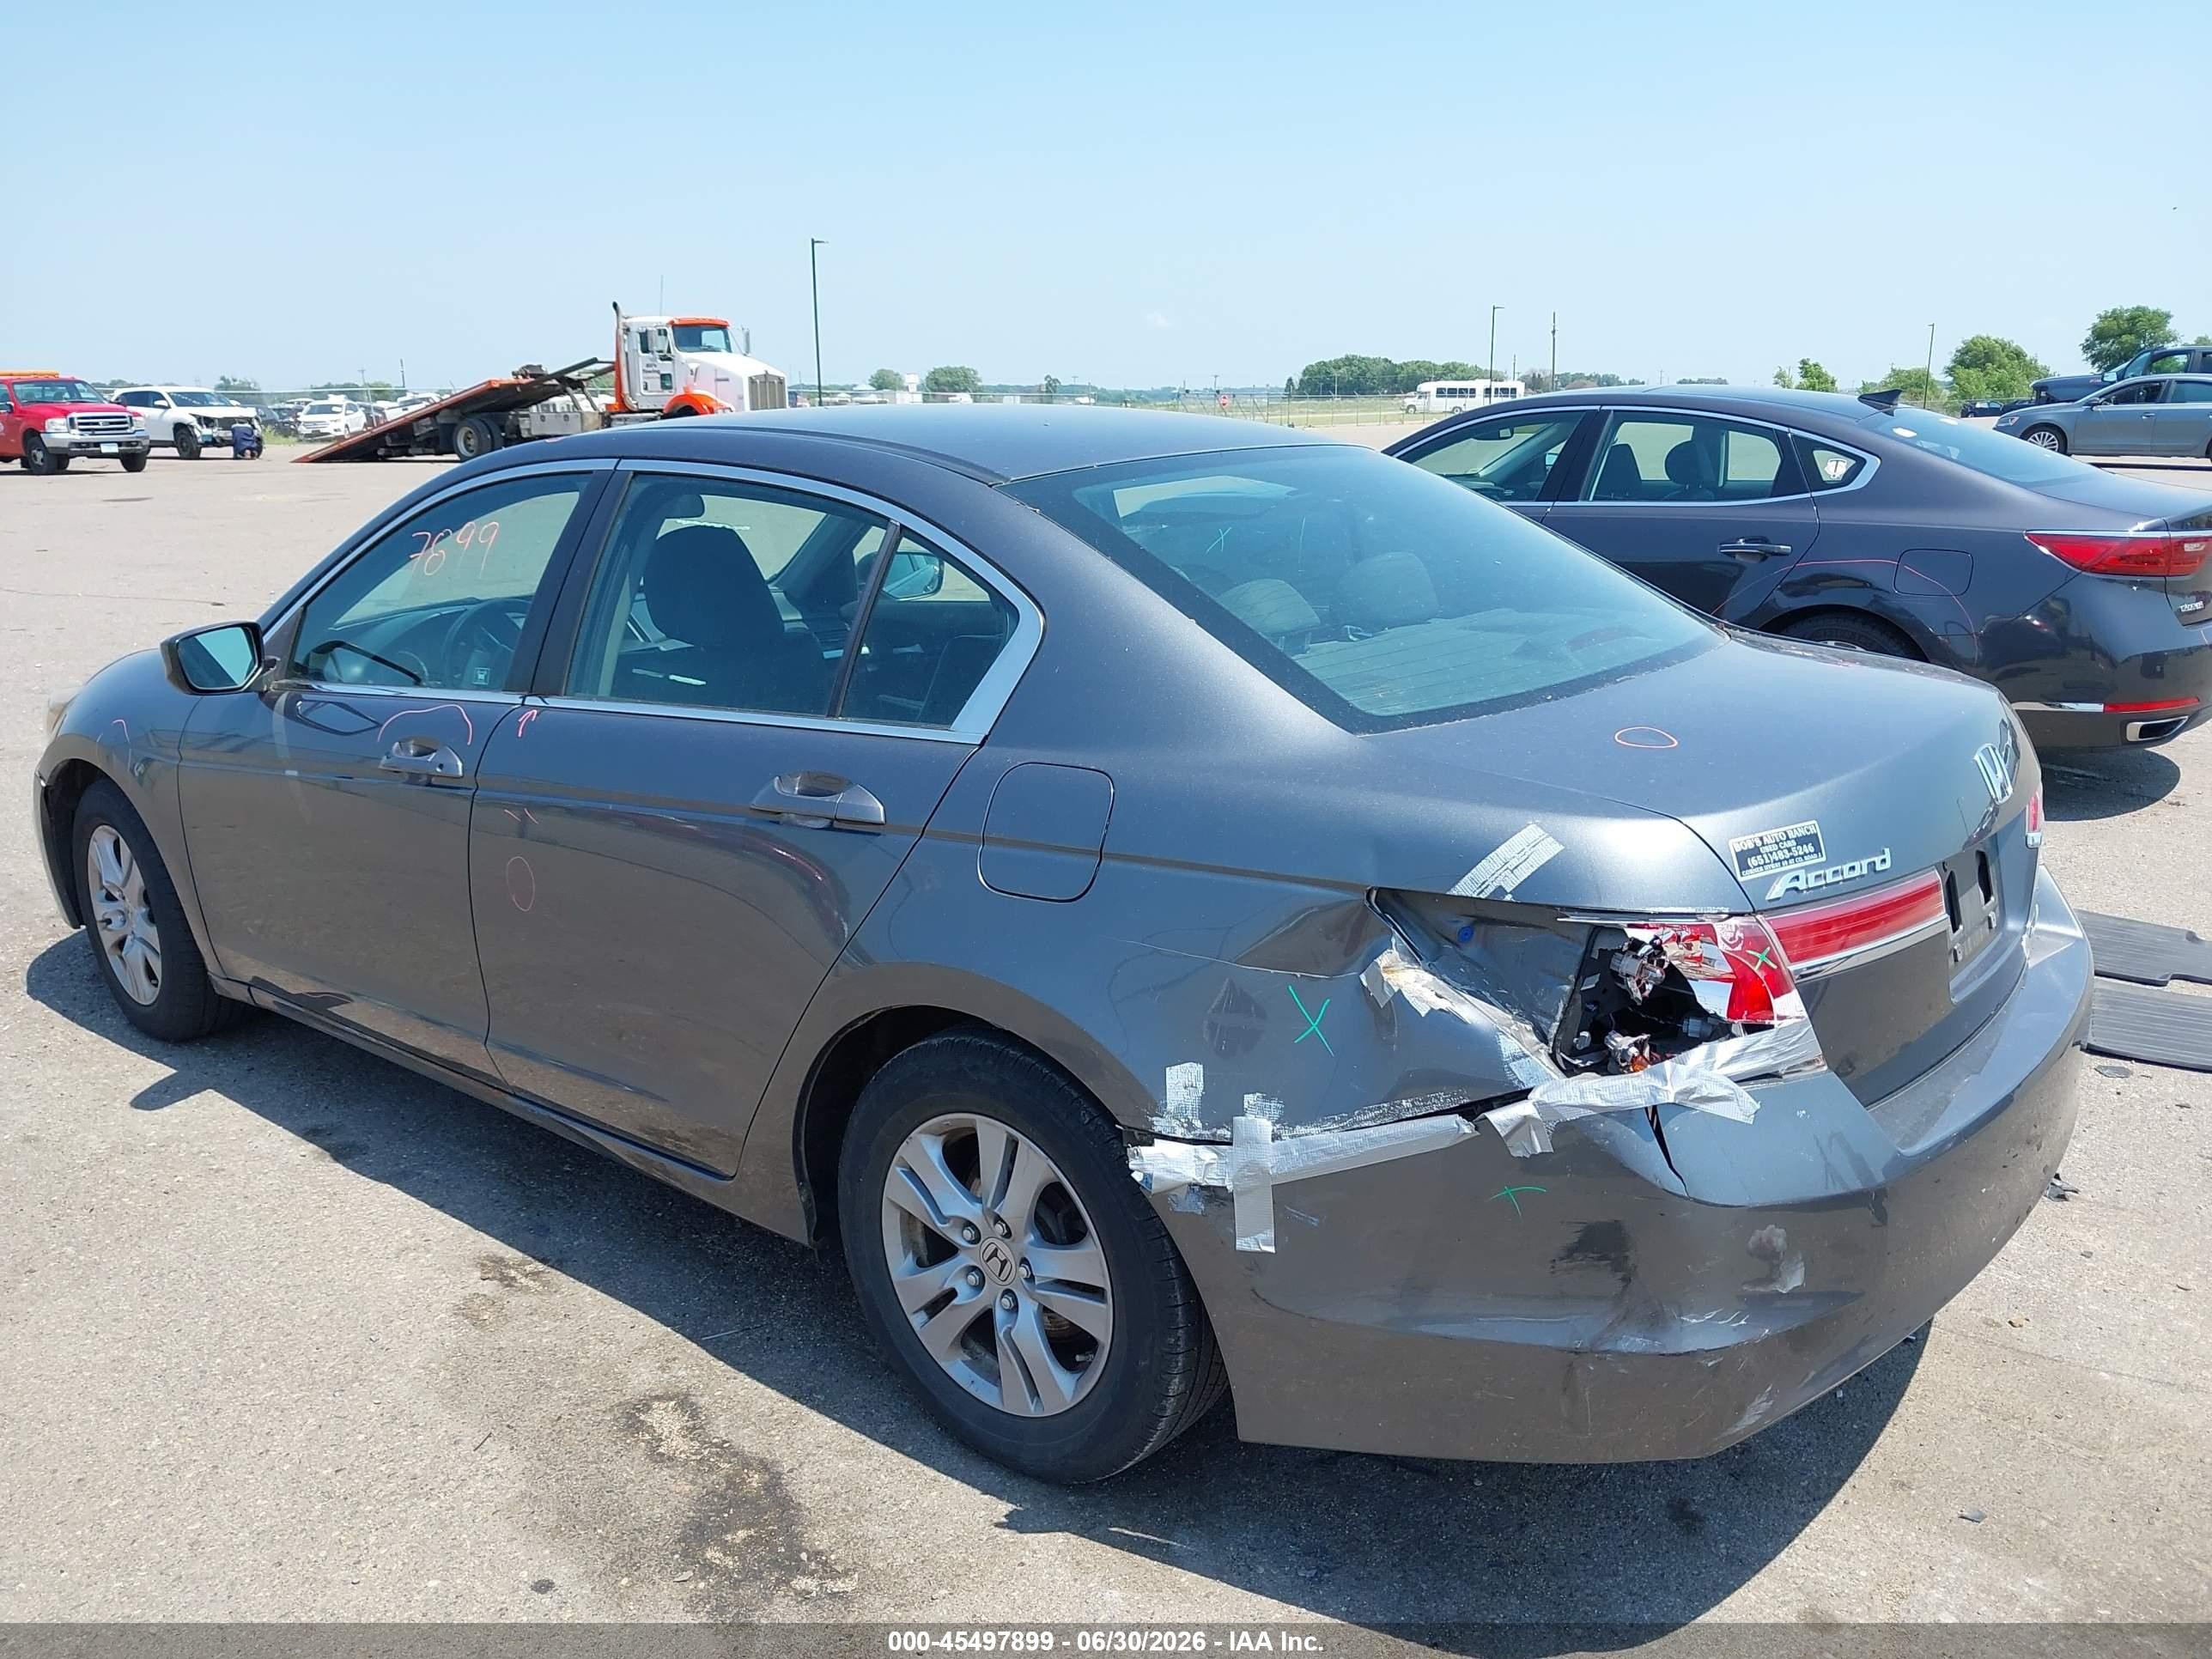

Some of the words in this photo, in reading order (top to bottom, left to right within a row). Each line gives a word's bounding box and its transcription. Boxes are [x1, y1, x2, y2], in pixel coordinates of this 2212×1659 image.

[410, 521, 499, 579] 7899
[1733, 837, 1762, 853] BOB'S
[1763, 831, 1787, 845] AUTO
[1786, 824, 1817, 840] RANCH
[1759, 844, 1778, 854] USED
[1778, 839, 1797, 848] CARS
[1765, 848, 1892, 901] Accord
